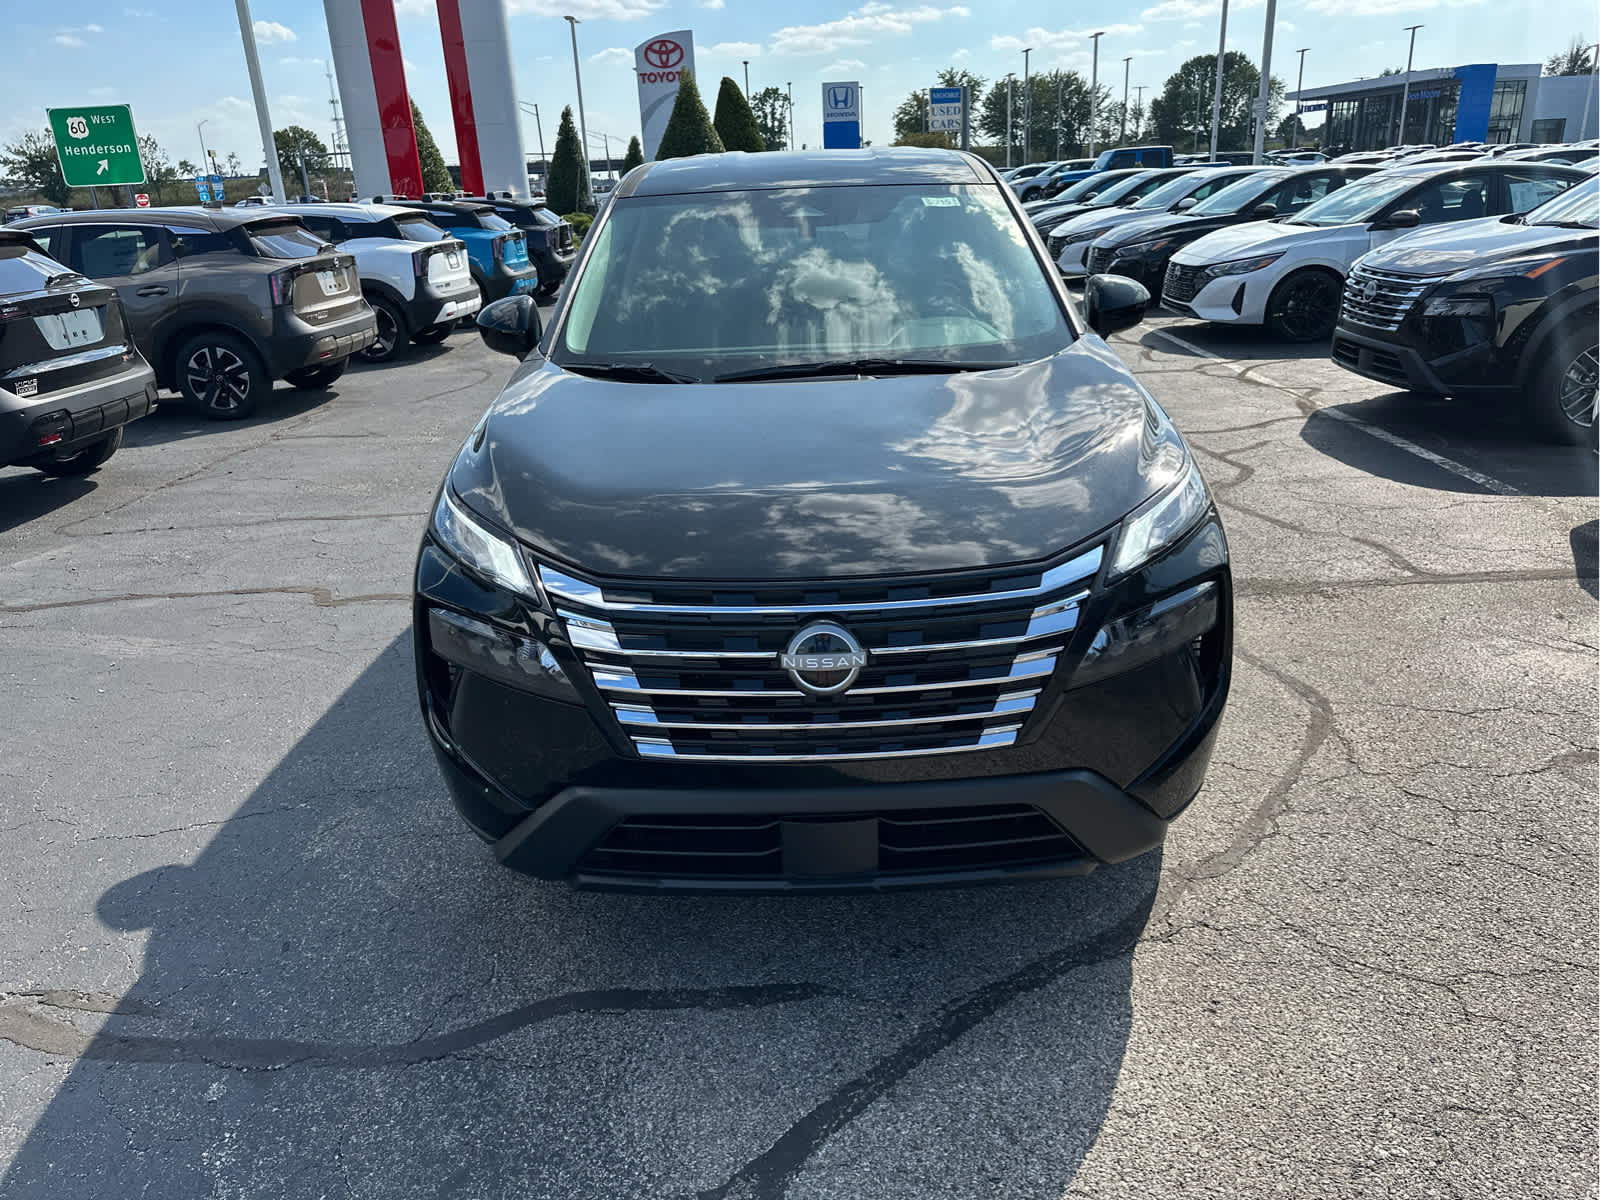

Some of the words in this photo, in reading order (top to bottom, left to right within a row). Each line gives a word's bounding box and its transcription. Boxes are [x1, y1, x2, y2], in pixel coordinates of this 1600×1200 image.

[639, 71, 683, 84] TOYOT
[931, 105, 961, 116] USED
[70, 120, 87, 135] 60
[90, 114, 115, 125] WEST
[931, 119, 961, 129] CARS
[64, 143, 132, 156] Henderson
[783, 655, 865, 668] NISSAN
